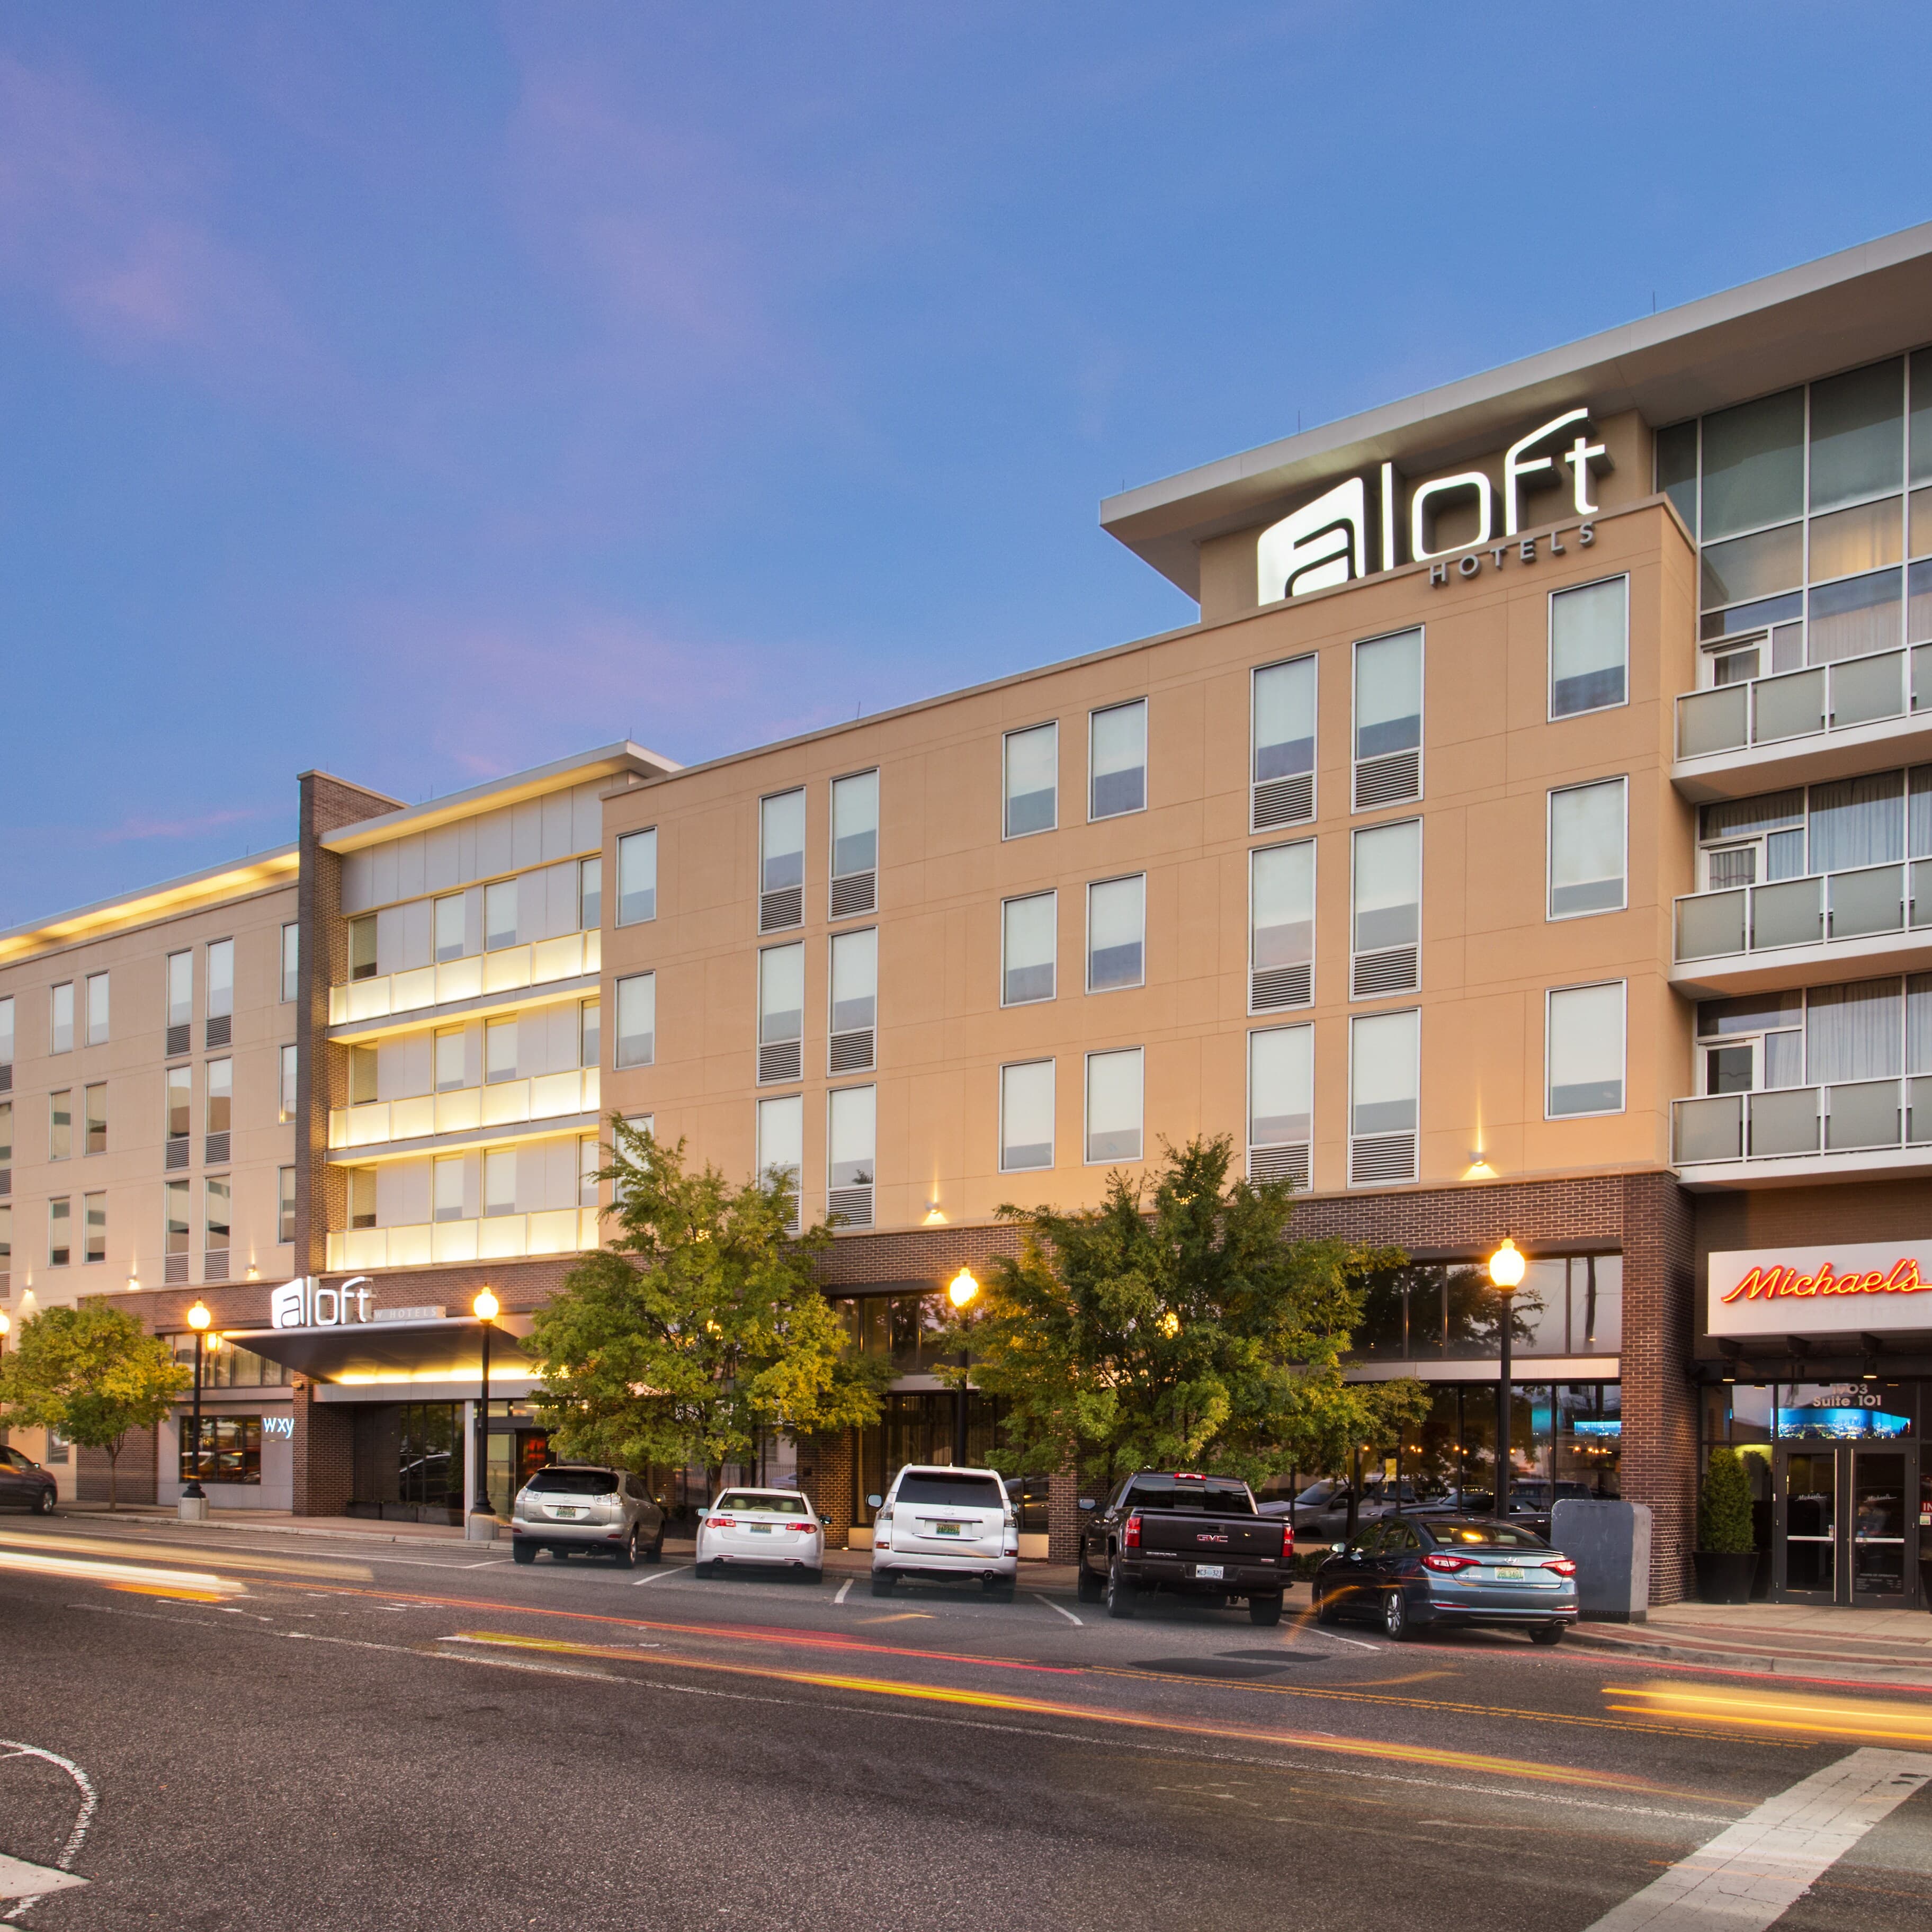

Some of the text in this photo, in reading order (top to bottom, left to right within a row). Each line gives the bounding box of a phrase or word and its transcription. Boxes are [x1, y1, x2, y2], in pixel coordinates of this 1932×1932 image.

[1257, 407, 1605, 607] aloft
[1429, 521, 1599, 587] HOTELS
[271, 1276, 371, 1329] aloft
[1721, 1258, 1932, 1303] Michael's
[389, 1307, 437, 1319] HOTELS
[1813, 1395, 1882, 1407] Suite 101
